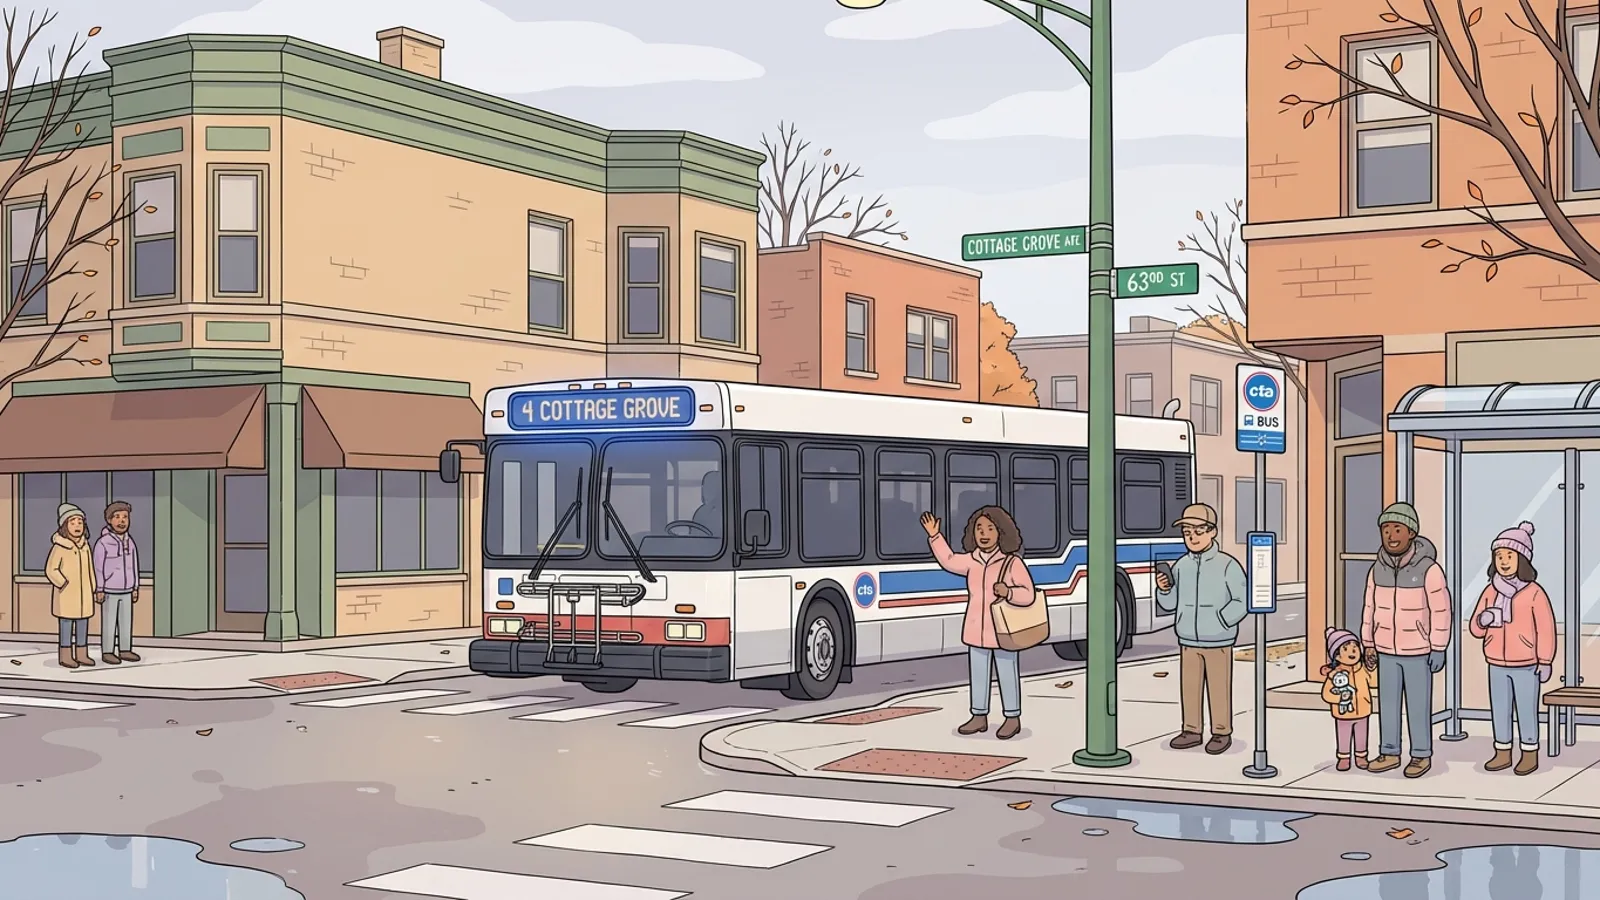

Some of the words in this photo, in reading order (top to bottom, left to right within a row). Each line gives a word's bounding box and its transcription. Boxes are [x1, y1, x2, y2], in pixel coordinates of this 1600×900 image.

[967, 236, 1018, 255] COTTAGE
[1170, 272, 1186, 288] ST
[522, 400, 533, 423] 4
[540, 398, 618, 422] COTTAGE
[623, 396, 681, 419] GROVE
[1257, 416, 1279, 428] BUS
